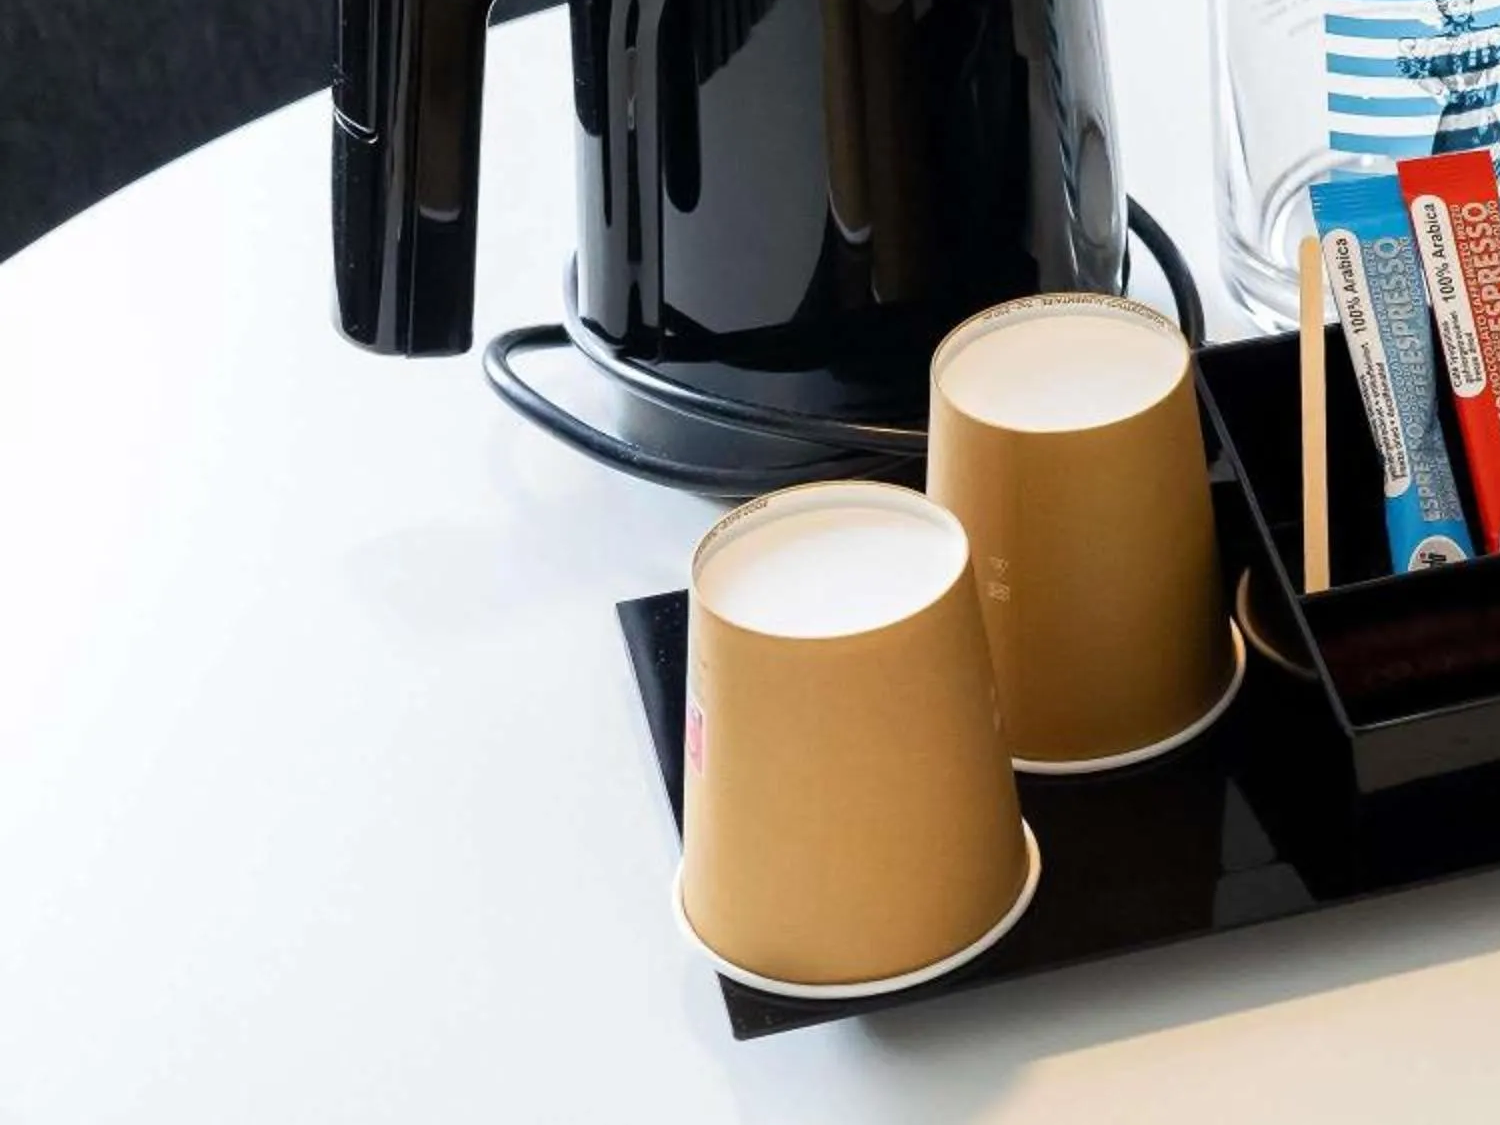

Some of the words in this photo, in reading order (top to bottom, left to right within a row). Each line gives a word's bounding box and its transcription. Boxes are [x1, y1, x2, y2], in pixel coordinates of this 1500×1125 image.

[1423, 203, 1445, 259] Arabica
[1336, 238, 1355, 293] Arabica
[1436, 263, 1457, 302] 100%
[1348, 297, 1366, 334] 100%
[1374, 238, 1425, 364] ESPRESSO
